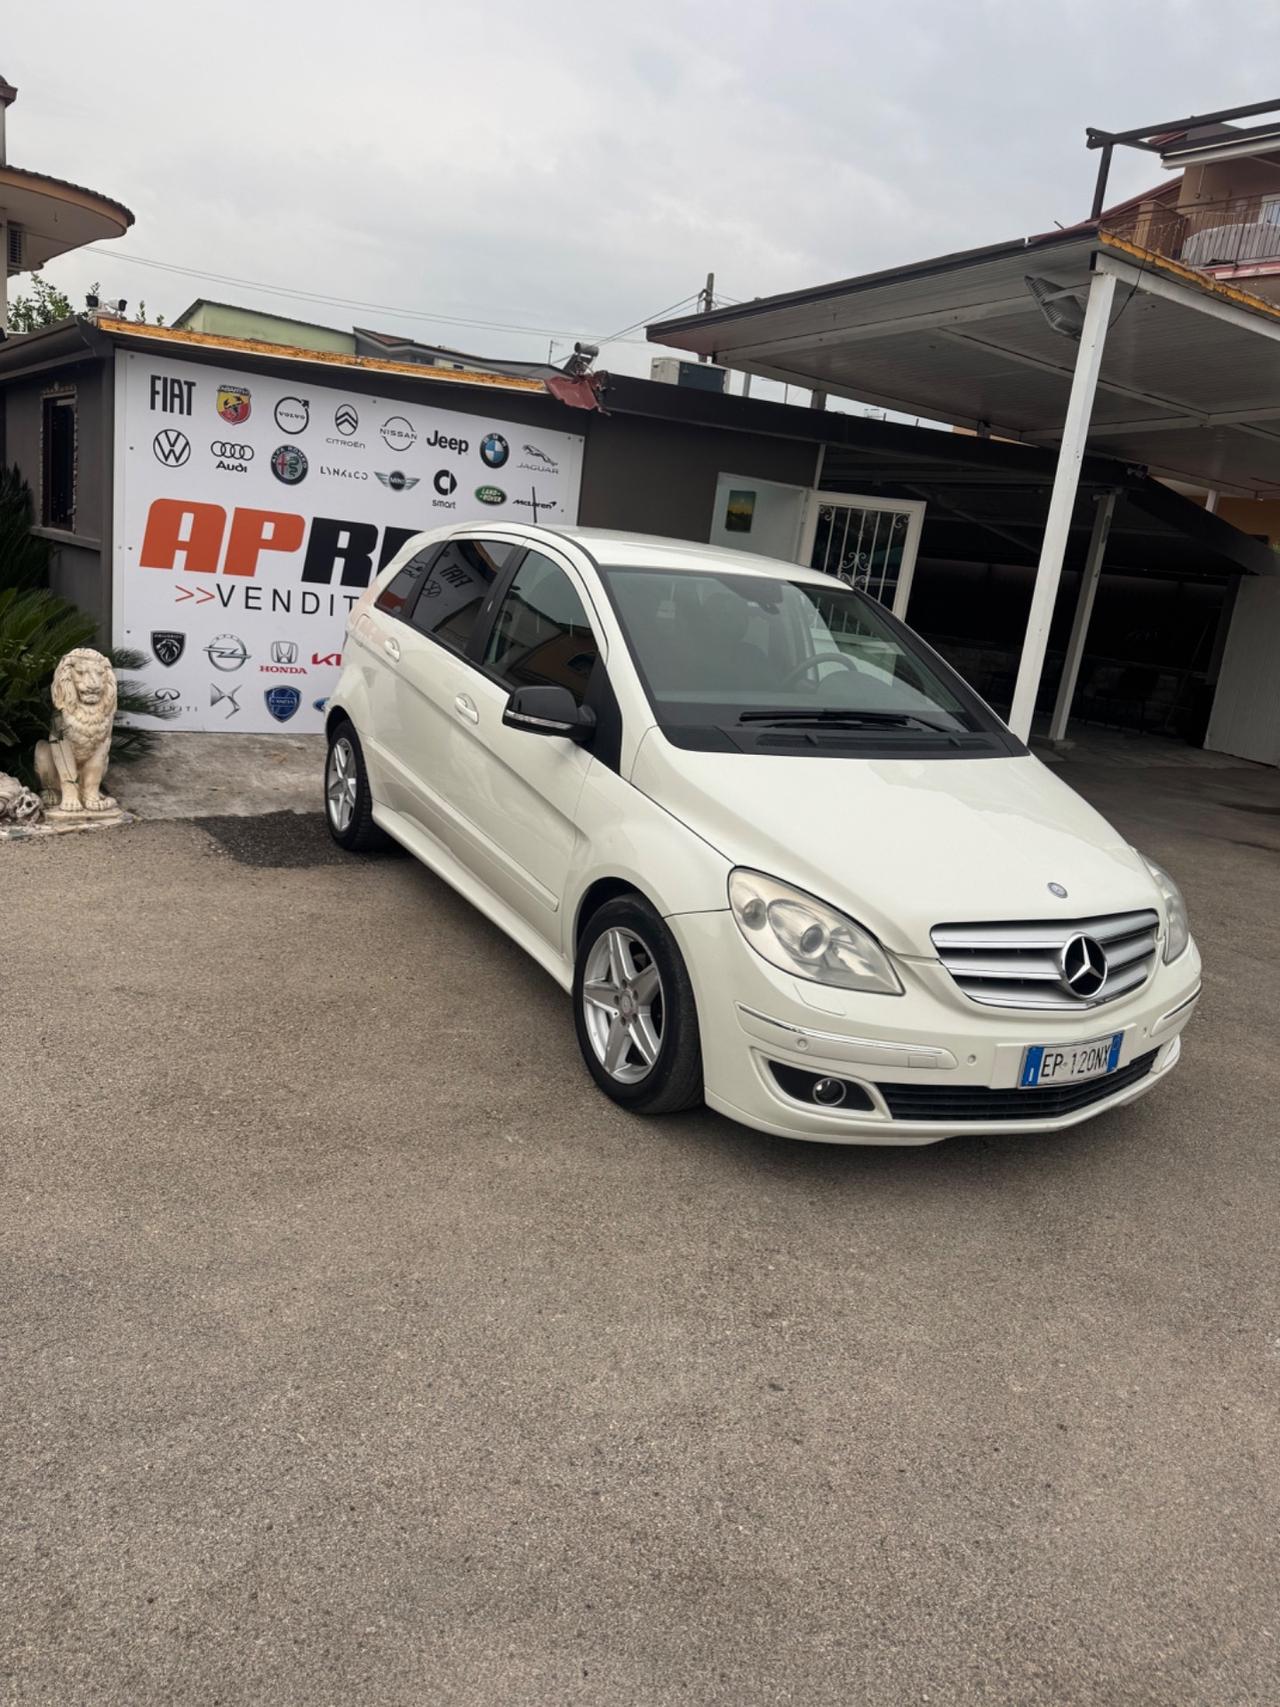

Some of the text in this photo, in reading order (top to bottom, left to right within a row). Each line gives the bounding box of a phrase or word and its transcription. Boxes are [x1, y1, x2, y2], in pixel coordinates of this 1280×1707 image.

[150, 374, 196, 416] FIAT
[279, 411, 305, 421] VOLVO
[379, 428, 418, 440] NISSAN
[426, 430, 469, 455] Jeep
[216, 460, 248, 473] Audi
[516, 462, 559, 475] JAGUAR
[432, 499, 456, 509] smart
[260, 665, 308, 675] HONDA
[1041, 1053, 1064, 1077] EP
[1070, 1044, 1111, 1075] 120NX
